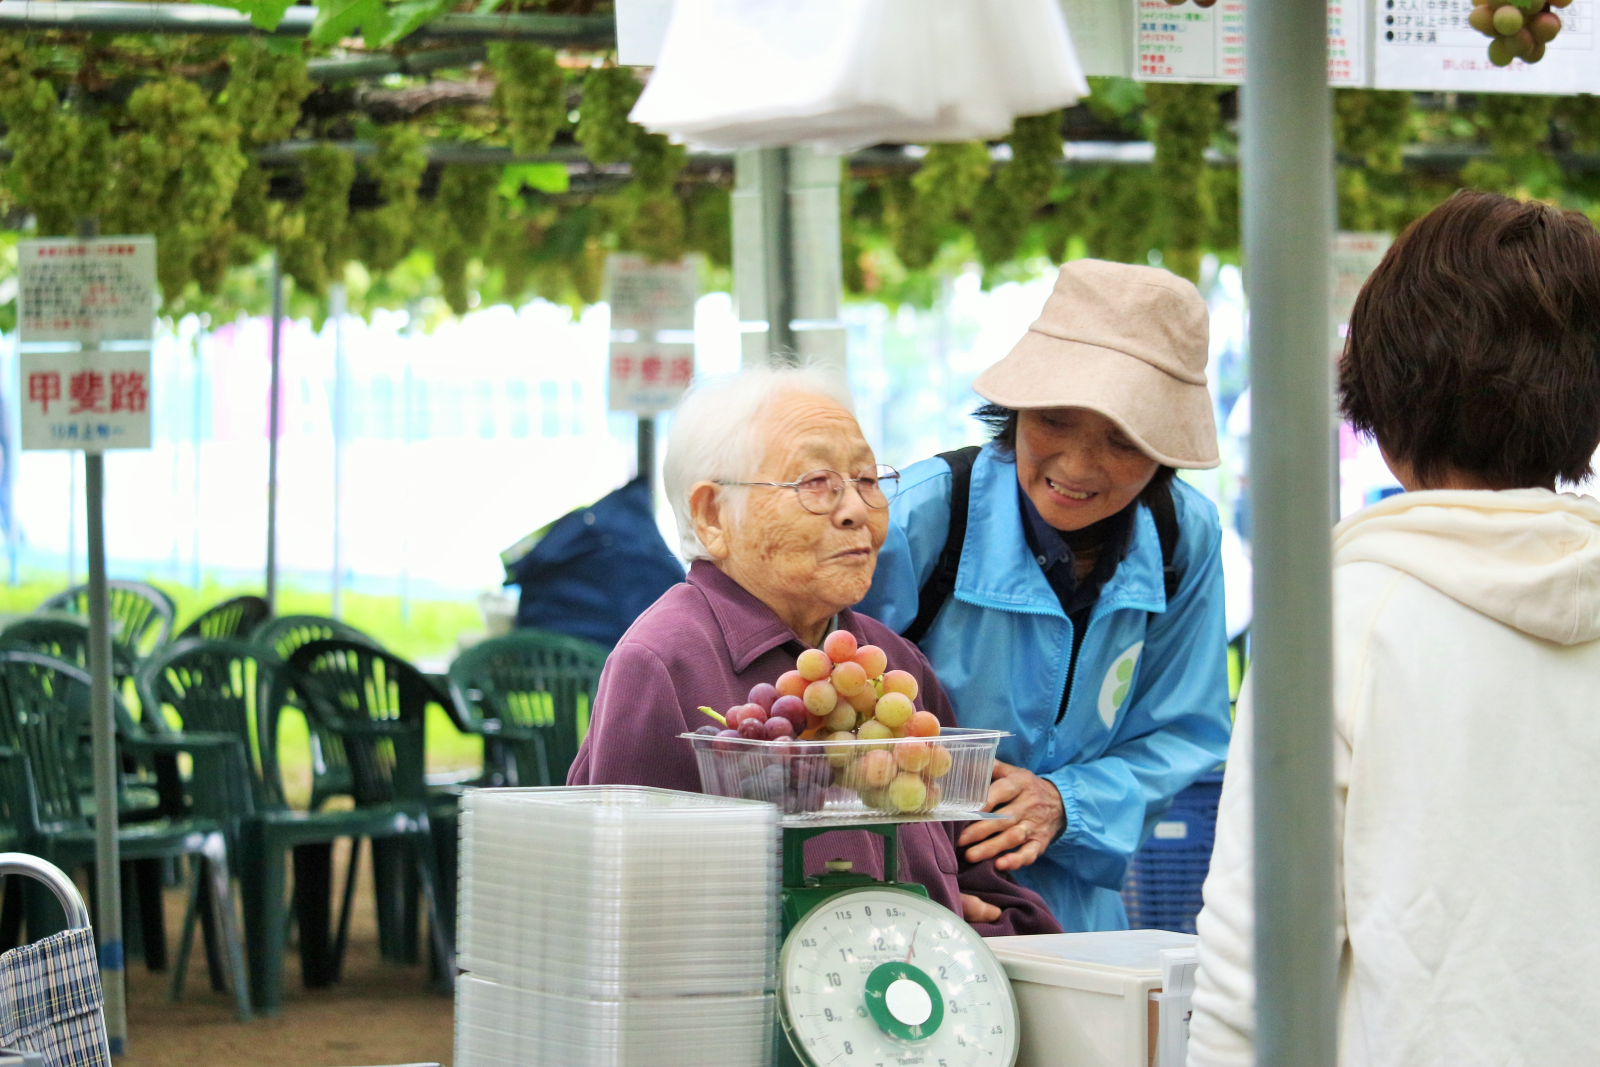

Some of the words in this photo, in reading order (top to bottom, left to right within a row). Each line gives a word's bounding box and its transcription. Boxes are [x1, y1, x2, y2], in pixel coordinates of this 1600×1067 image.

[29, 370, 148, 415] 甲斐路
[835, 911, 852, 920] 11.5
[864, 905, 872, 917] 0
[801, 938, 817, 948] 10.5
[826, 972, 842, 987] 10
[938, 966, 948, 980] 2
[975, 974, 988, 983] 2.5
[843, 1040, 853, 1055] 8
